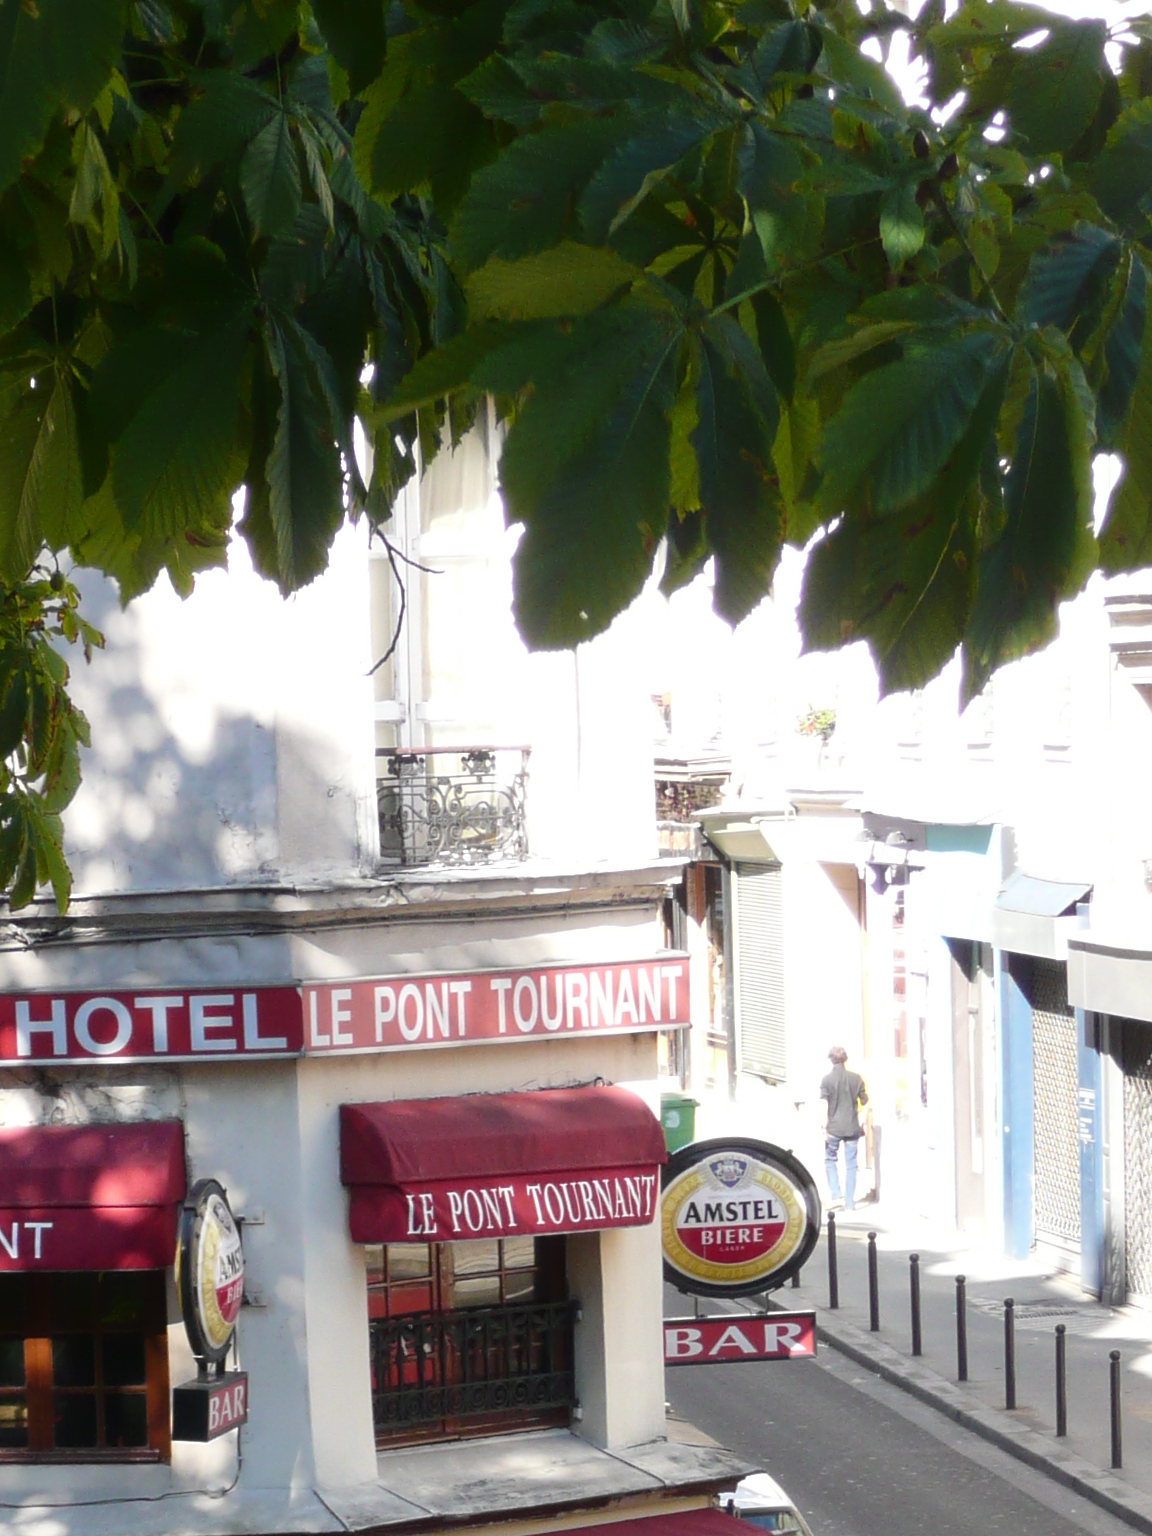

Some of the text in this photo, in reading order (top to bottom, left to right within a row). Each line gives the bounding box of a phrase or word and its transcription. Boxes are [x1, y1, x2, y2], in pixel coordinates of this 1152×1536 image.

[16, 994, 286, 1056] HOTEL
[309, 965, 683, 1046] LE PONT TOURNANT
[406, 1194, 438, 1235] LE
[447, 1186, 515, 1233] PONT
[527, 1174, 655, 1227] TOURNANT
[685, 1200, 778, 1224] AMSTEL
[701, 1229, 763, 1245] BIERE
[666, 1323, 806, 1358] BAR
[209, 1385, 245, 1430] BAR
